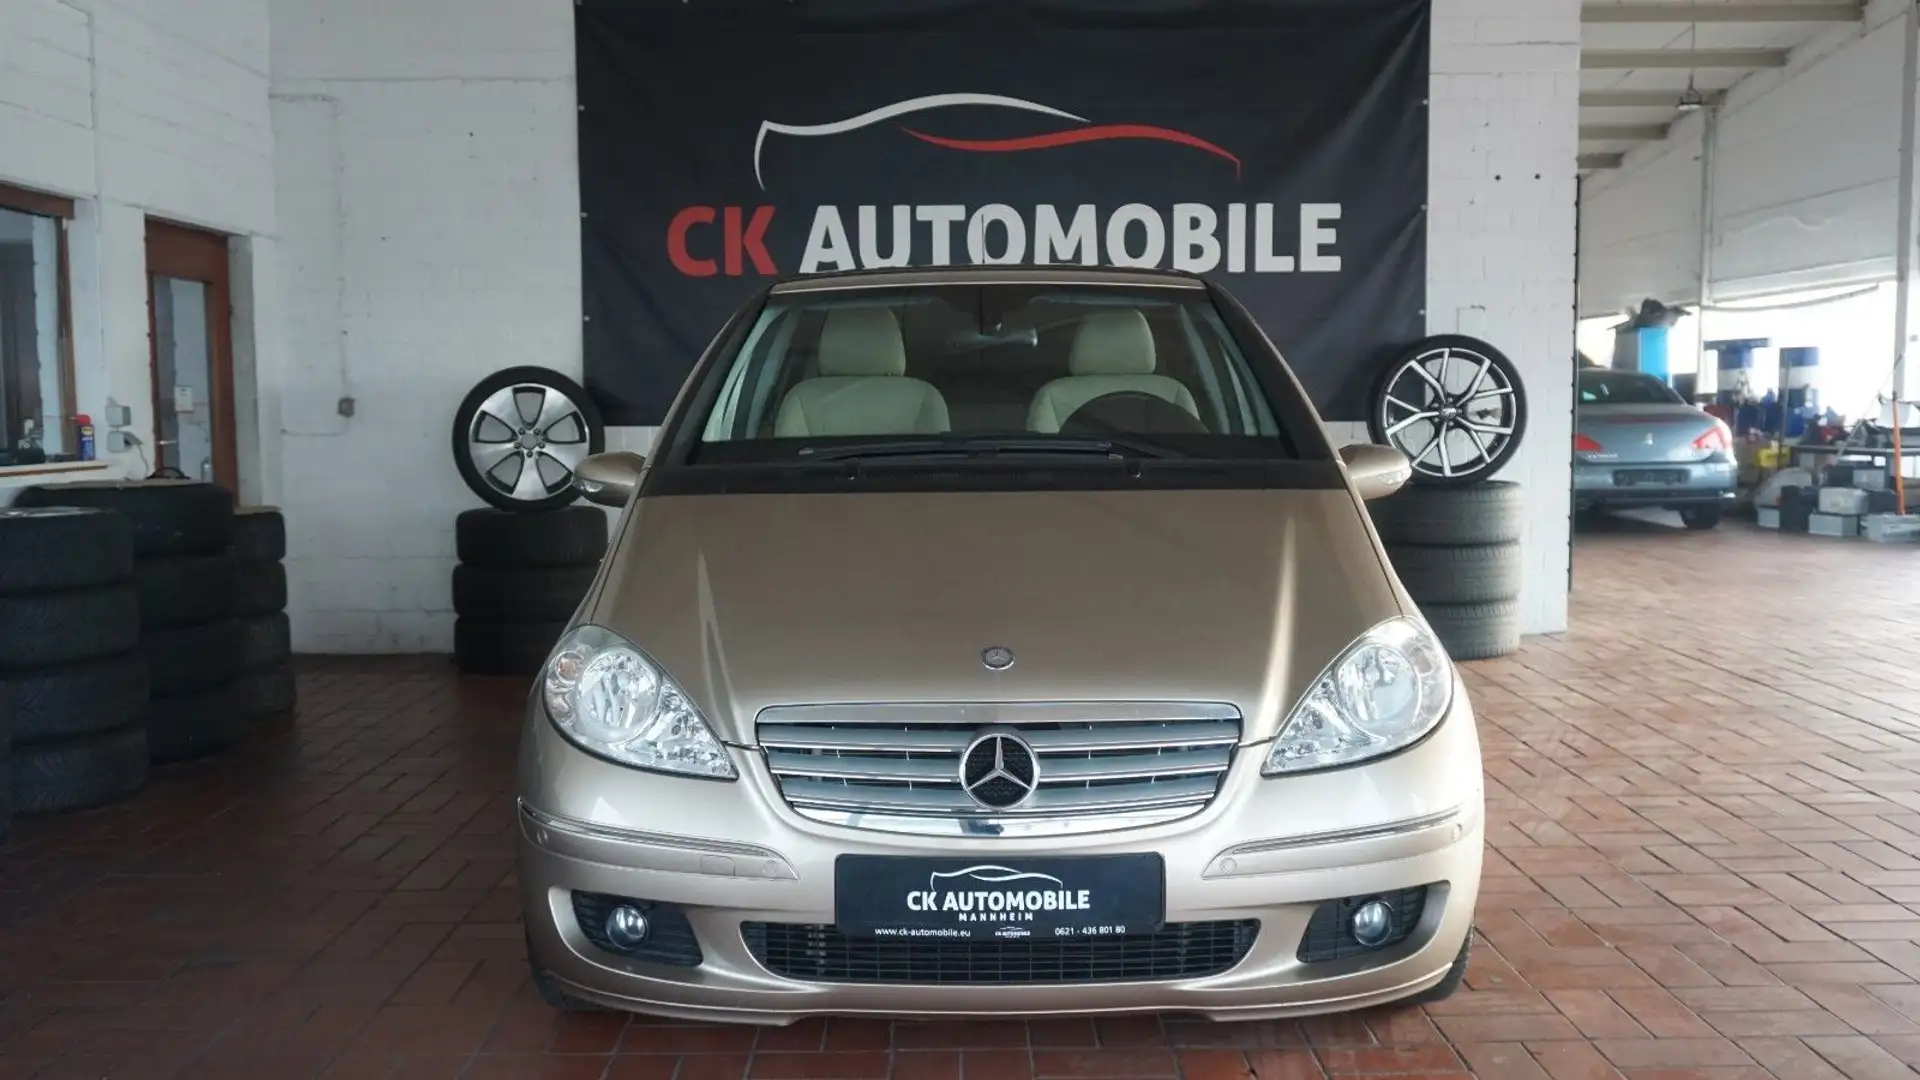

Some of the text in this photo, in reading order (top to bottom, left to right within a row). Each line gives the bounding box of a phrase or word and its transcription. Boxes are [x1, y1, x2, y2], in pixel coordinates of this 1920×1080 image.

[666, 202, 1342, 277] CK AUTOMOBILE
[907, 890, 1091, 911] CK AUTOMOBILE
[958, 912, 1034, 921] MANNHEIM
[874, 927, 971, 937] www.ck-automobile.eu
[1054, 927, 1074, 936] 0621
